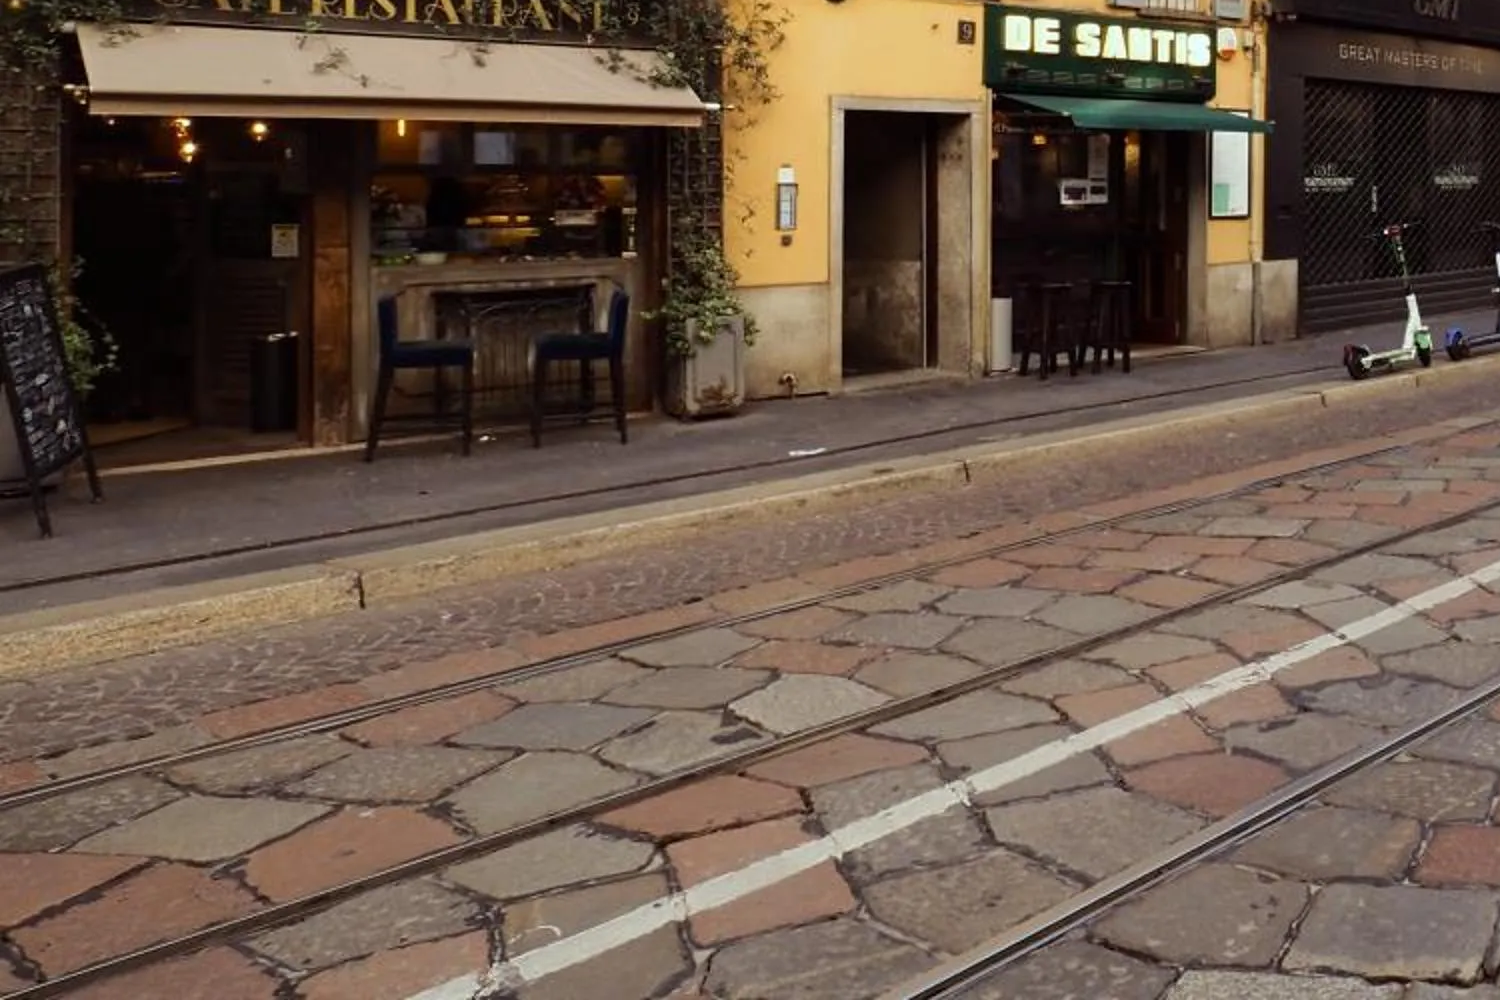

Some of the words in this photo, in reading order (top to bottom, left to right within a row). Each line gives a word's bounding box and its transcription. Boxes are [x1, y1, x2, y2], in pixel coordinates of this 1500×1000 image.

[1005, 15, 1060, 54] DE
[1076, 22, 1211, 67] SANTIS
[1339, 43, 1380, 64] GREAT
